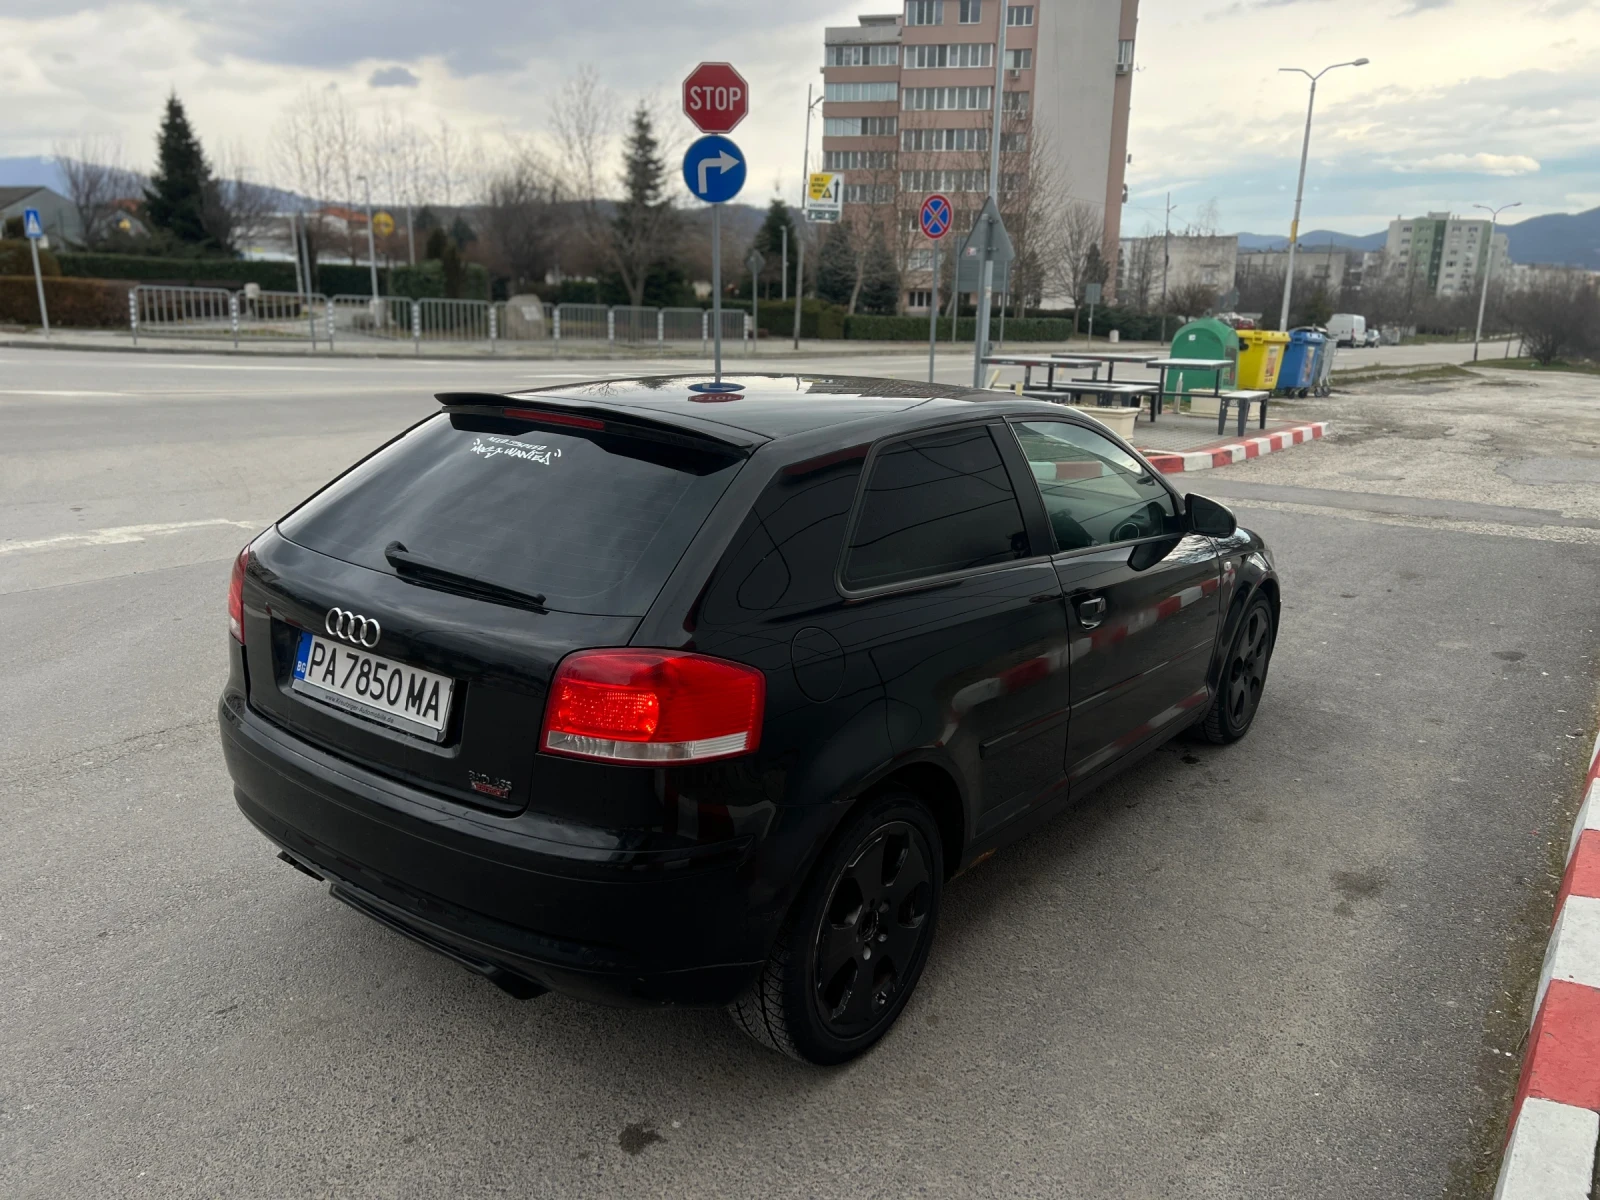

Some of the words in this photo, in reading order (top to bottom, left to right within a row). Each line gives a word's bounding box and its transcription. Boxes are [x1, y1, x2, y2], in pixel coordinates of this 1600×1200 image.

[689, 85, 742, 111] STOP
[504, 447, 551, 465] WANTED
[296, 660, 306, 673] BG
[308, 641, 337, 686] PA
[340, 652, 403, 706] 7850
[405, 673, 441, 722] MA
